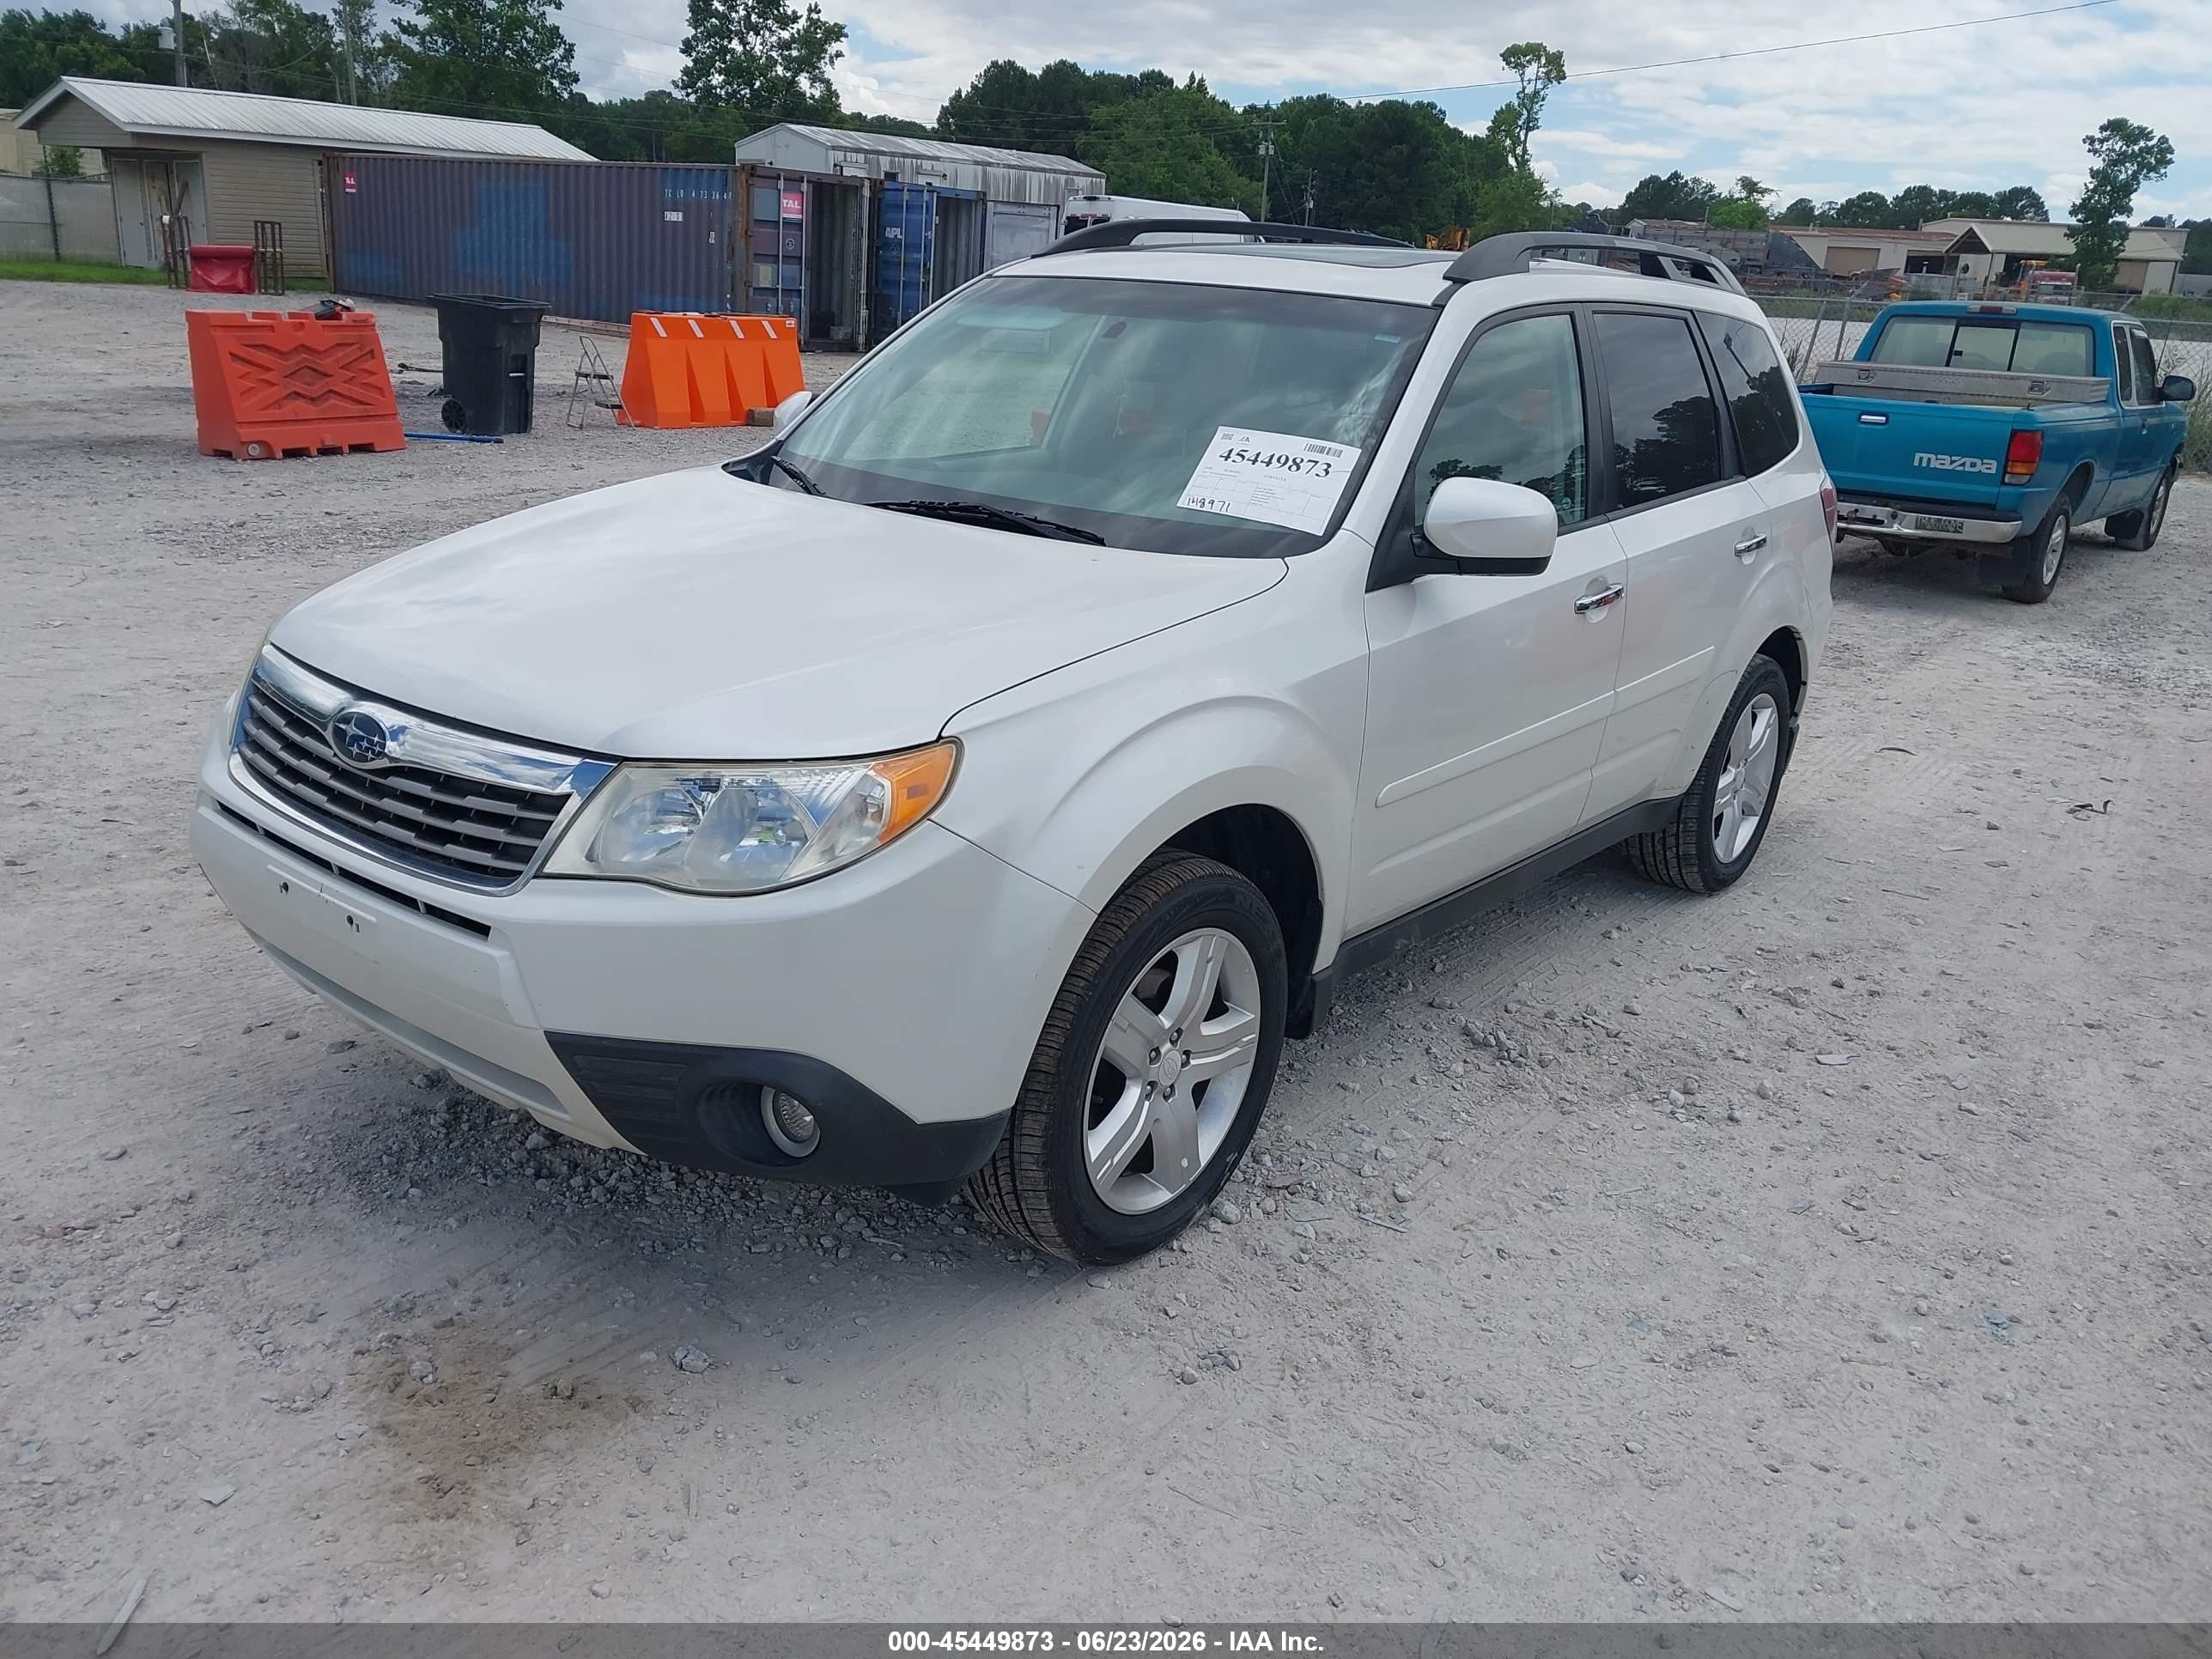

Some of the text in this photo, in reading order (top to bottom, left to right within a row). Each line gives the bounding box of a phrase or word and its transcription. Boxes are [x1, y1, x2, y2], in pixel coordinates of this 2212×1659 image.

[782, 198, 801, 209] TAL
[885, 227, 902, 239] APL
[1218, 447, 1332, 478] 45449873
